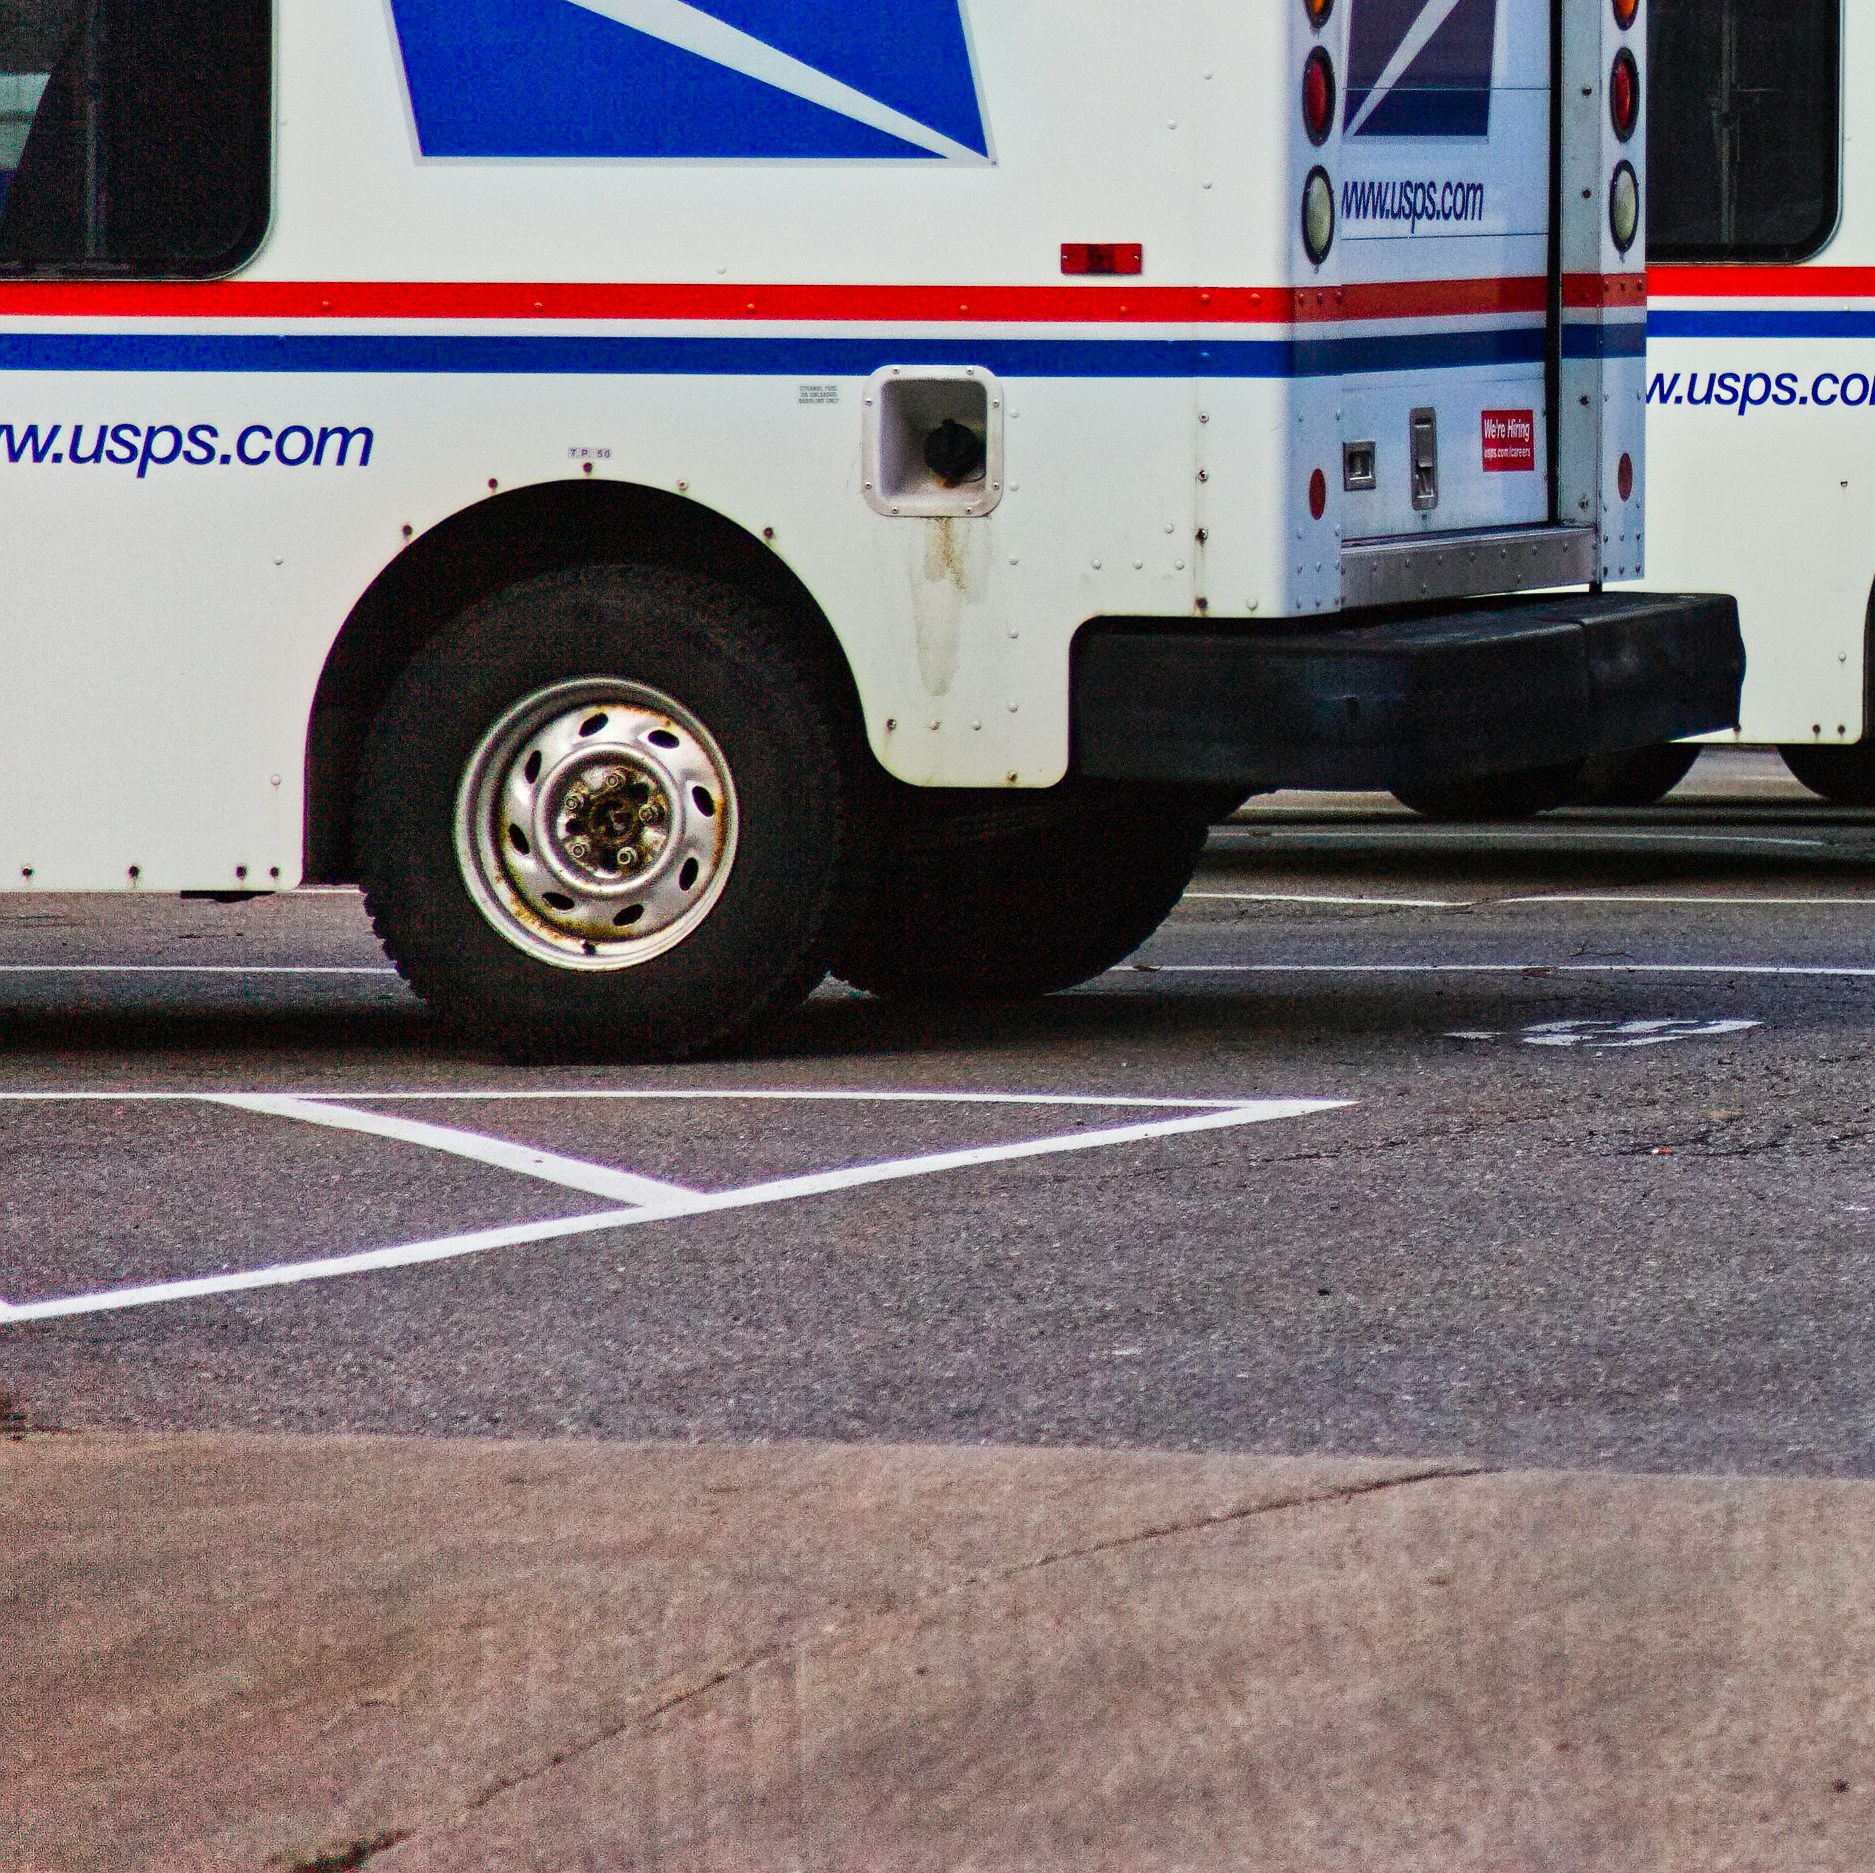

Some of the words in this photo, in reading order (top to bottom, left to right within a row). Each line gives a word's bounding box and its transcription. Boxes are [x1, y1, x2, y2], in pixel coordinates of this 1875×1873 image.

[1341, 180, 1484, 234] www.usps.com
[0, 424, 374, 478] w.usps.com
[1484, 418, 1506, 439] We're
[1507, 418, 1530, 443] Hiring
